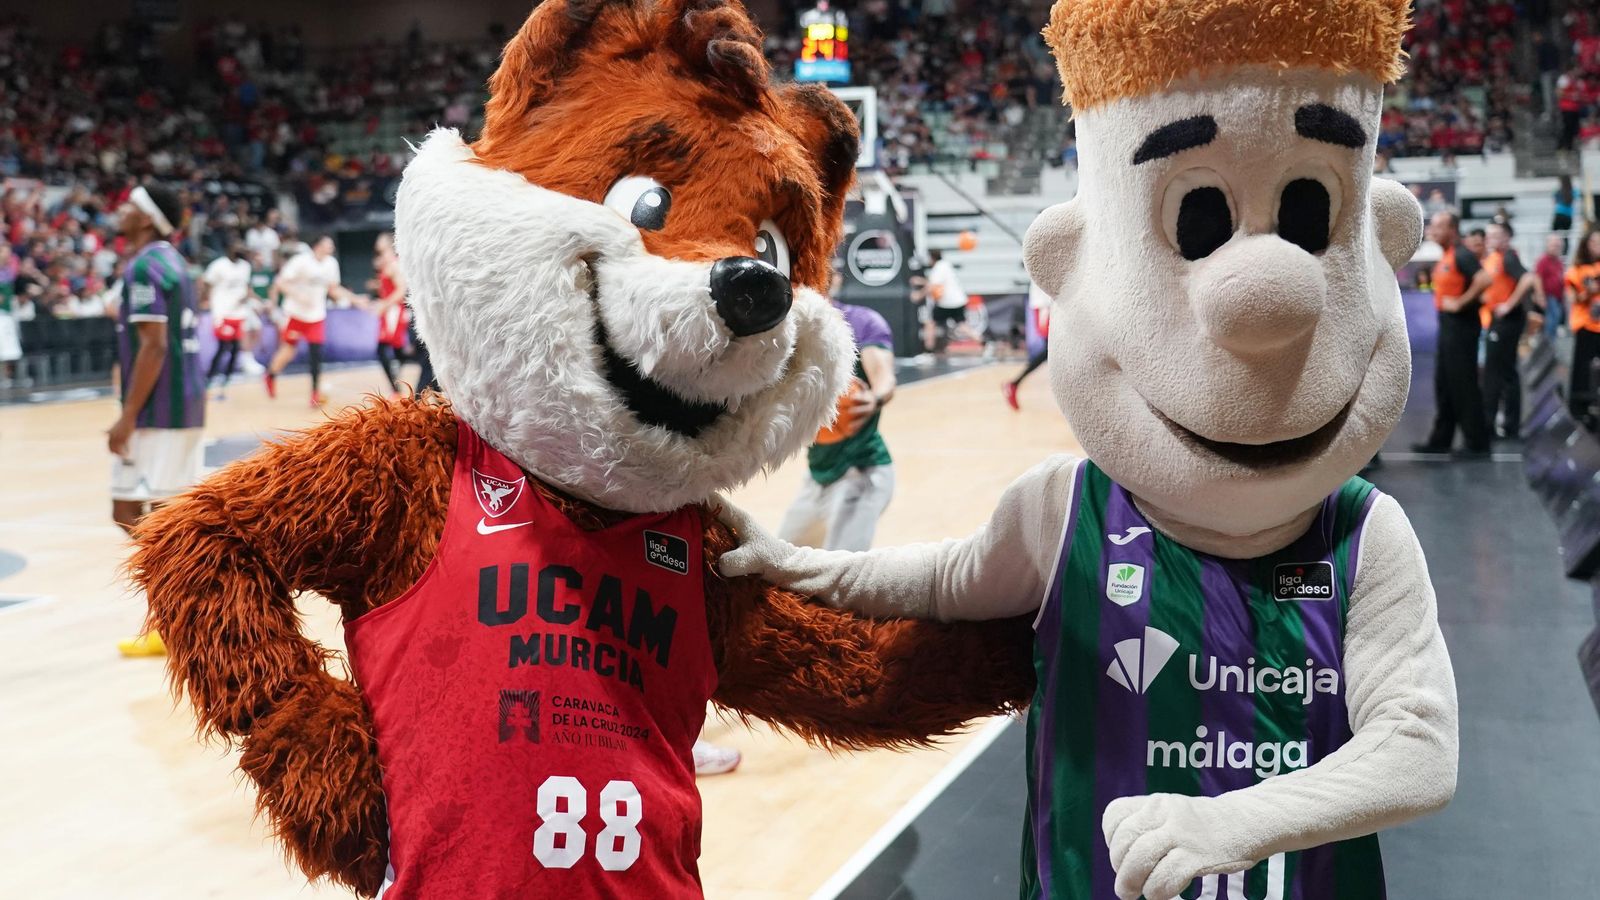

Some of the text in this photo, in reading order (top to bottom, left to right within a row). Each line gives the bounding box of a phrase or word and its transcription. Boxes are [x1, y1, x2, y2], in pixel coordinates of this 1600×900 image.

[486, 479, 509, 489] UCAM
[649, 540, 667, 553] liga
[650, 551, 685, 569] endesa
[1279, 574, 1302, 586] liga
[1279, 583, 1330, 595] endesa
[478, 563, 678, 669] UCAM
[509, 633, 644, 693] MURCIA
[1188, 653, 1340, 705] Unicaja
[552, 695, 619, 716] CARAVACA
[552, 713, 650, 740] DE LA CRUZ 2024
[552, 729, 628, 751] AÑO JUBILAR
[1146, 725, 1308, 779] málaga
[532, 775, 643, 872] 88
